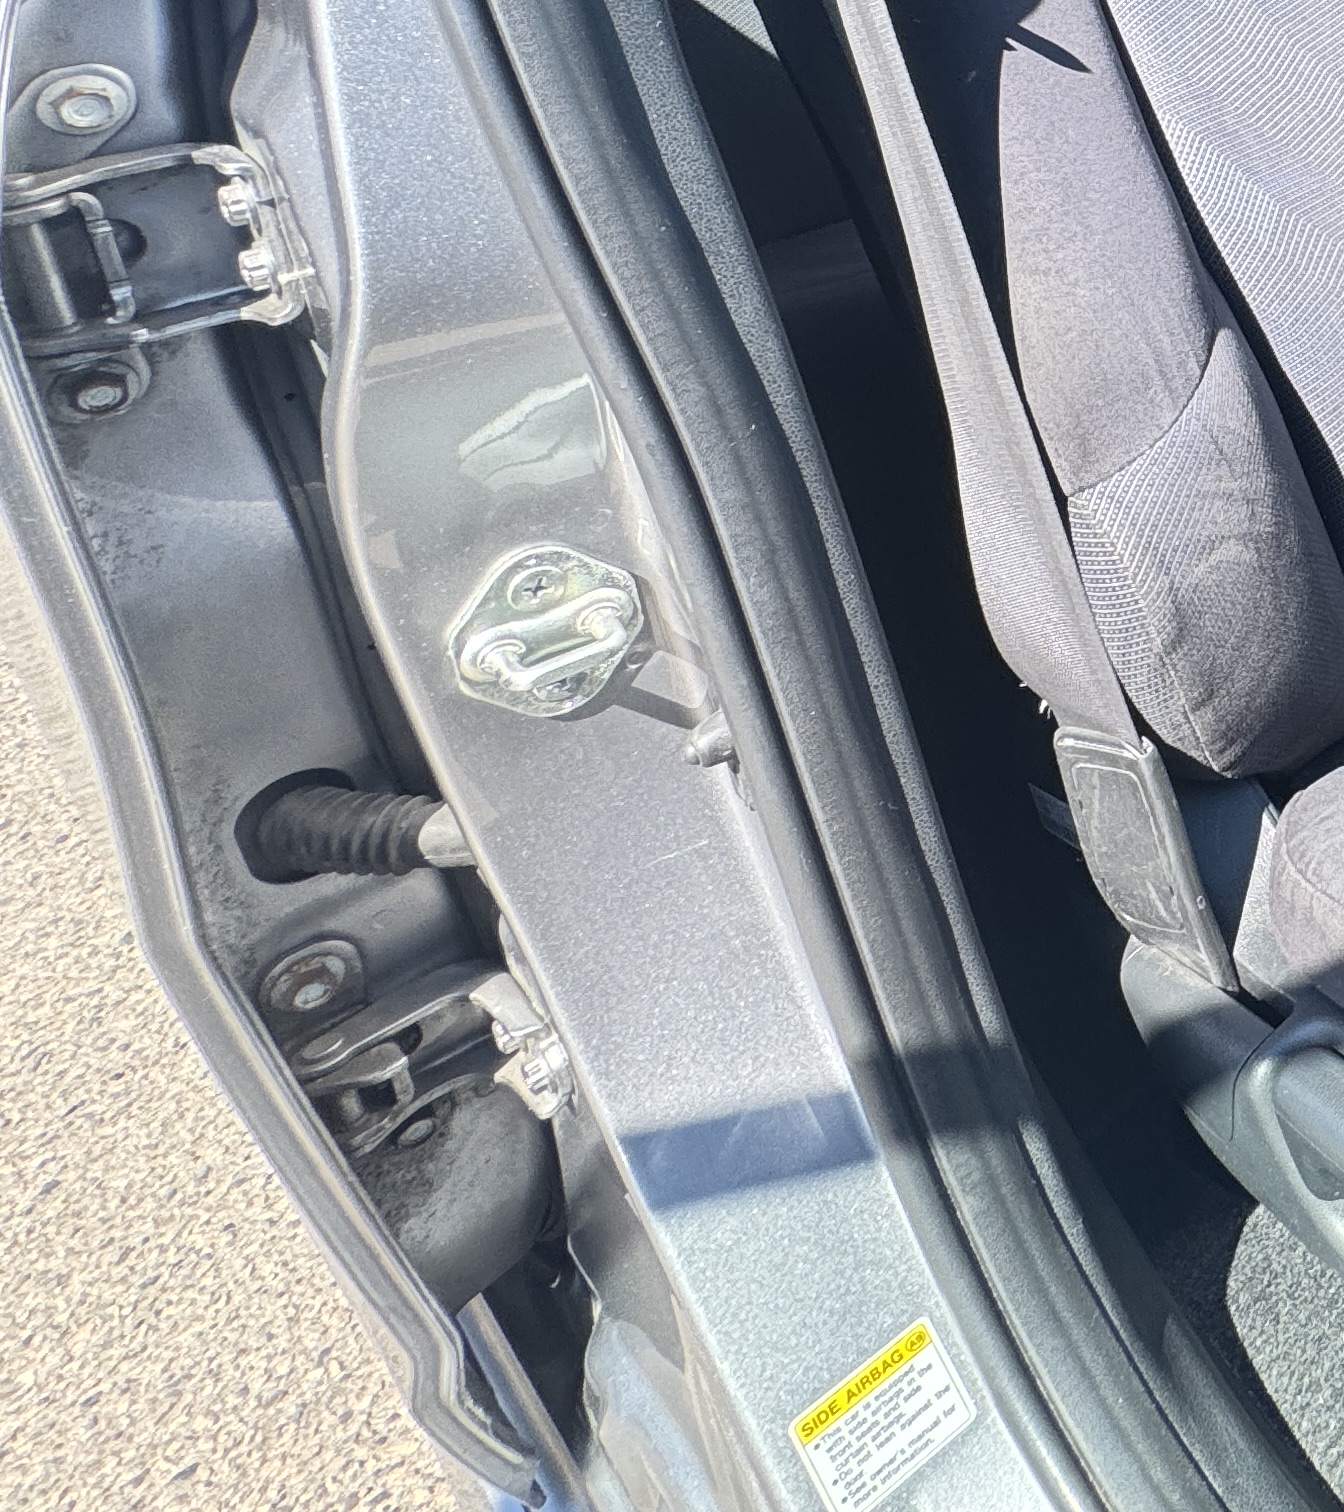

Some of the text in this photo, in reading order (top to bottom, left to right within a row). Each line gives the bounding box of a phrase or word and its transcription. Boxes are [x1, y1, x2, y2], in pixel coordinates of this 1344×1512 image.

[801, 1399, 841, 1437] SIDE
[846, 1349, 904, 1404] AIRBAG
[819, 1364, 915, 1444] This car is equipped
[825, 1363, 933, 1454] with side airbags in the
[829, 1385, 922, 1463] front seats and side
[838, 1384, 951, 1481] Do not lean against the
[835, 1442, 868, 1472] curtain
[848, 1403, 956, 1499] See owner's manual for
[853, 1485, 878, 1509] more
